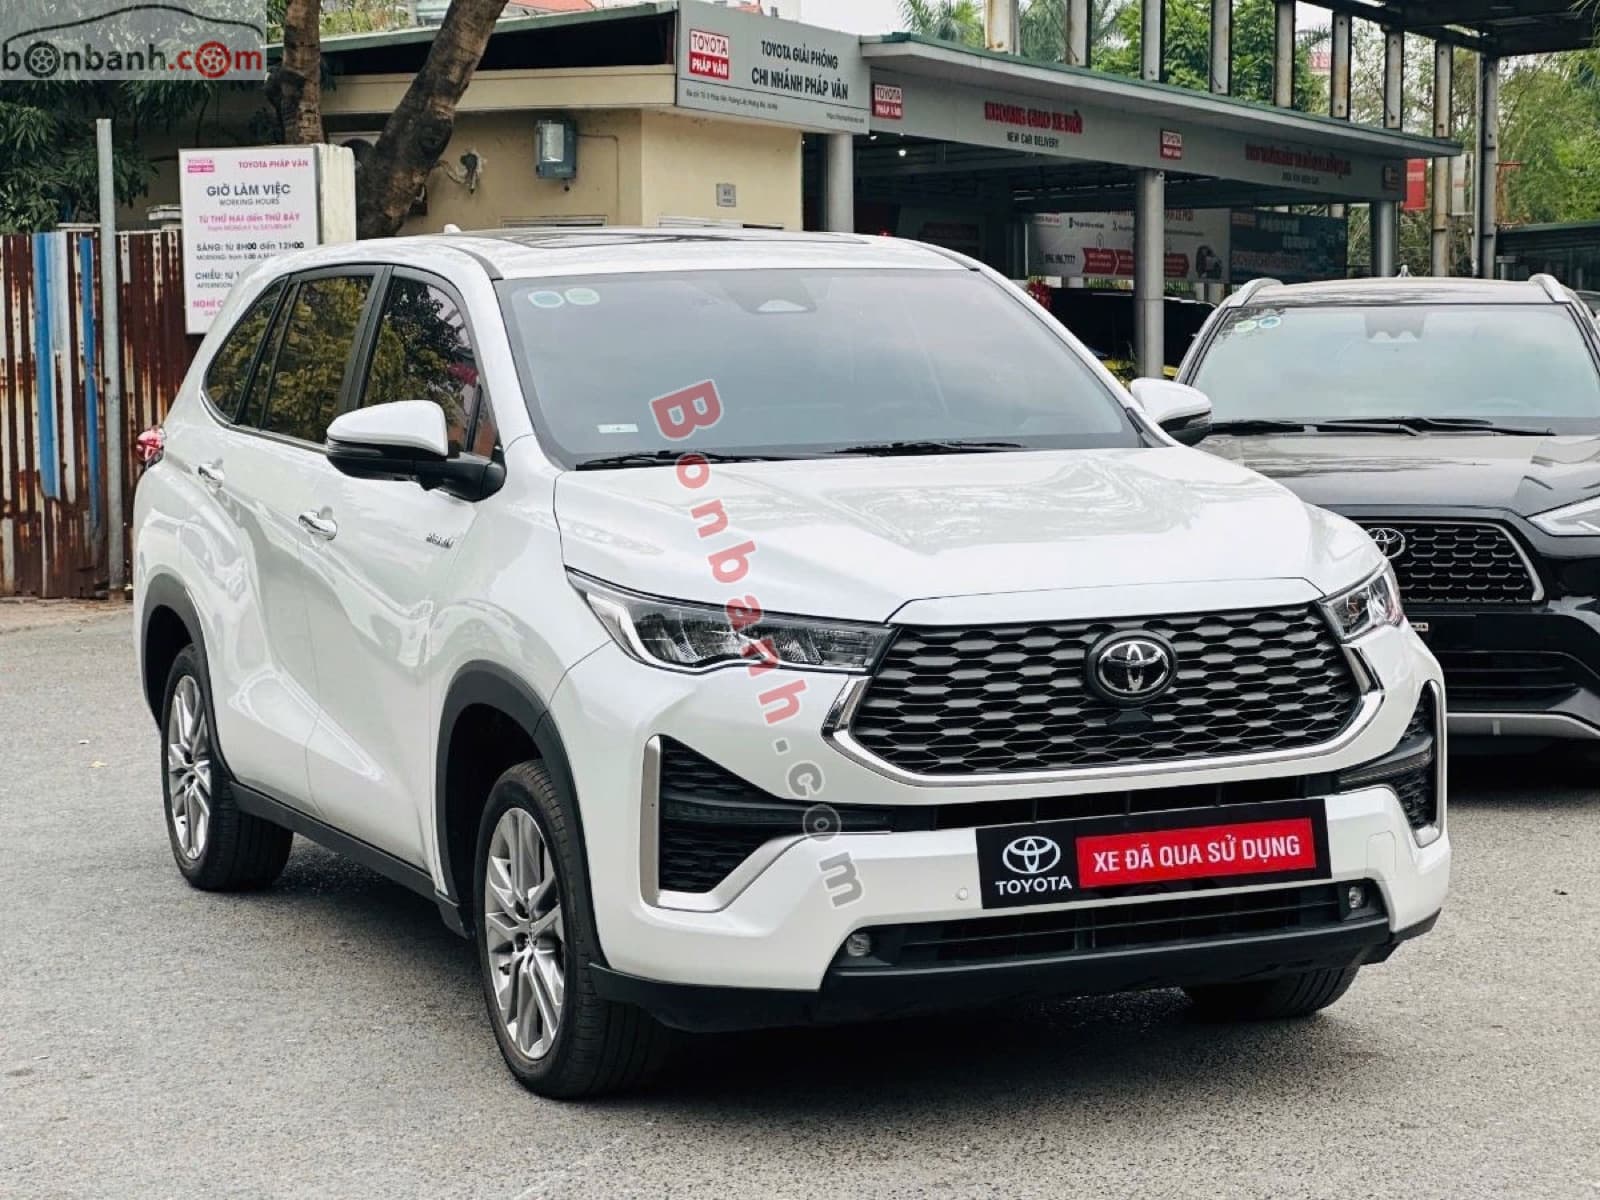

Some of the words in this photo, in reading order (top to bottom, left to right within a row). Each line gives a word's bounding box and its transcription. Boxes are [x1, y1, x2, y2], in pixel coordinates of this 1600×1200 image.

[692, 33, 728, 56] TOYOTA
[761, 40, 792, 61] TOYOTA
[792, 43, 809, 64] GIẢI
[811, 51, 839, 70] PHÓNG
[691, 58, 712, 75] PHÁP
[712, 60, 728, 76] VÂN
[751, 67, 769, 86] CHI
[770, 68, 802, 93] NHÁNH
[804, 74, 829, 97] PHÁP
[831, 79, 849, 100] VÂN
[876, 86, 901, 101] TOYOTA
[1051, 112, 1065, 132] XE
[1007, 131, 1019, 143] NEW
[1021, 132, 1033, 145] CAR
[1034, 134, 1059, 149] DELIVERY
[239, 161, 268, 169] TOYOTA
[269, 159, 290, 168] PHÁP
[207, 181, 231, 197] GIỜ
[234, 181, 260, 196] LÀM
[263, 181, 292, 198] VIỆC
[219, 198, 254, 206] WORKING
[255, 198, 280, 206] HOURS
[196, 241, 223, 252] SÁNG:
[278, 240, 305, 250] 12H00
[1093, 851, 1121, 873] XE
[1125, 843, 1155, 870] ĐÃ
[1160, 845, 1203, 868] QUA
[1207, 835, 1238, 863] SỬ
[1242, 835, 1301, 865] DỤNG
[995, 876, 1073, 896] TOYOTA
